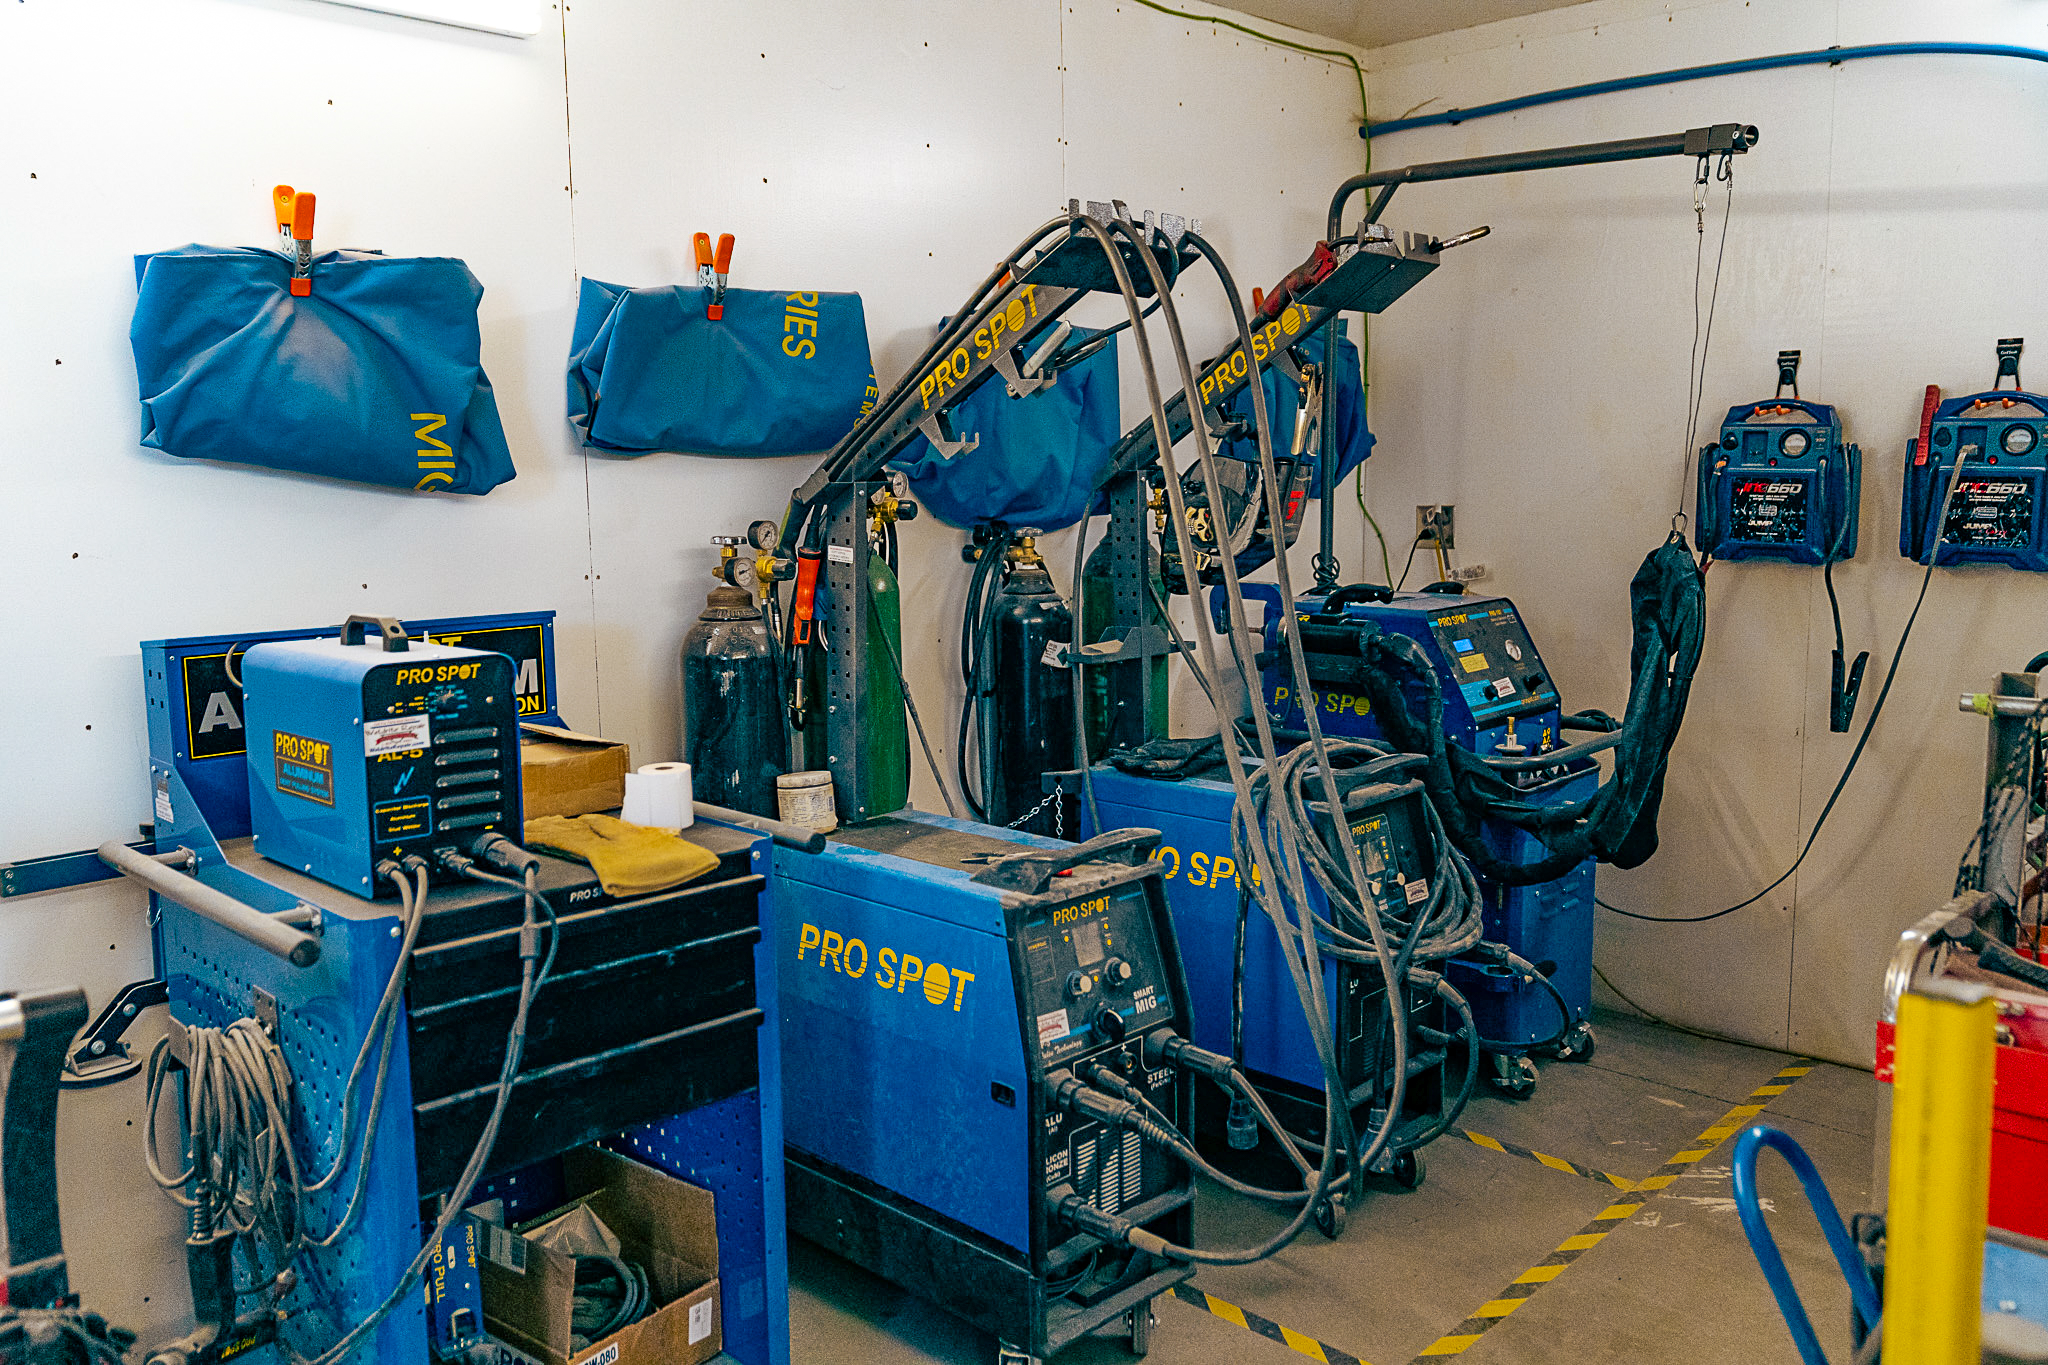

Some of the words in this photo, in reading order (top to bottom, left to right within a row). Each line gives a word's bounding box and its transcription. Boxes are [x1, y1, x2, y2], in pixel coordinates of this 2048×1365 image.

[919, 347, 970, 410] PRO
[974, 284, 1038, 360] SPOT
[1200, 350, 1248, 405] PRO
[1437, 616, 1452, 628] PRO
[1451, 613, 1468, 625] SPOT
[396, 667, 434, 686] PRO
[436, 663, 482, 682] SPOT
[275, 732, 299, 758] PRO
[300, 738, 330, 766] SPOT
[1352, 825, 1366, 837] PRO
[1365, 819, 1381, 833] SPOT
[570, 888, 592, 903] PRO
[1053, 905, 1079, 927] PRO
[1080, 896, 1111, 918] SPOT
[798, 922, 868, 979] PRO
[875, 947, 975, 1012] SPOT
[1133, 985, 1154, 1001] SMART
[1134, 995, 1157, 1014] MIG
[1147, 1066, 1175, 1085] STEEL
[466, 1245, 477, 1269] SPOT
[434, 1265, 446, 1304] PULL
